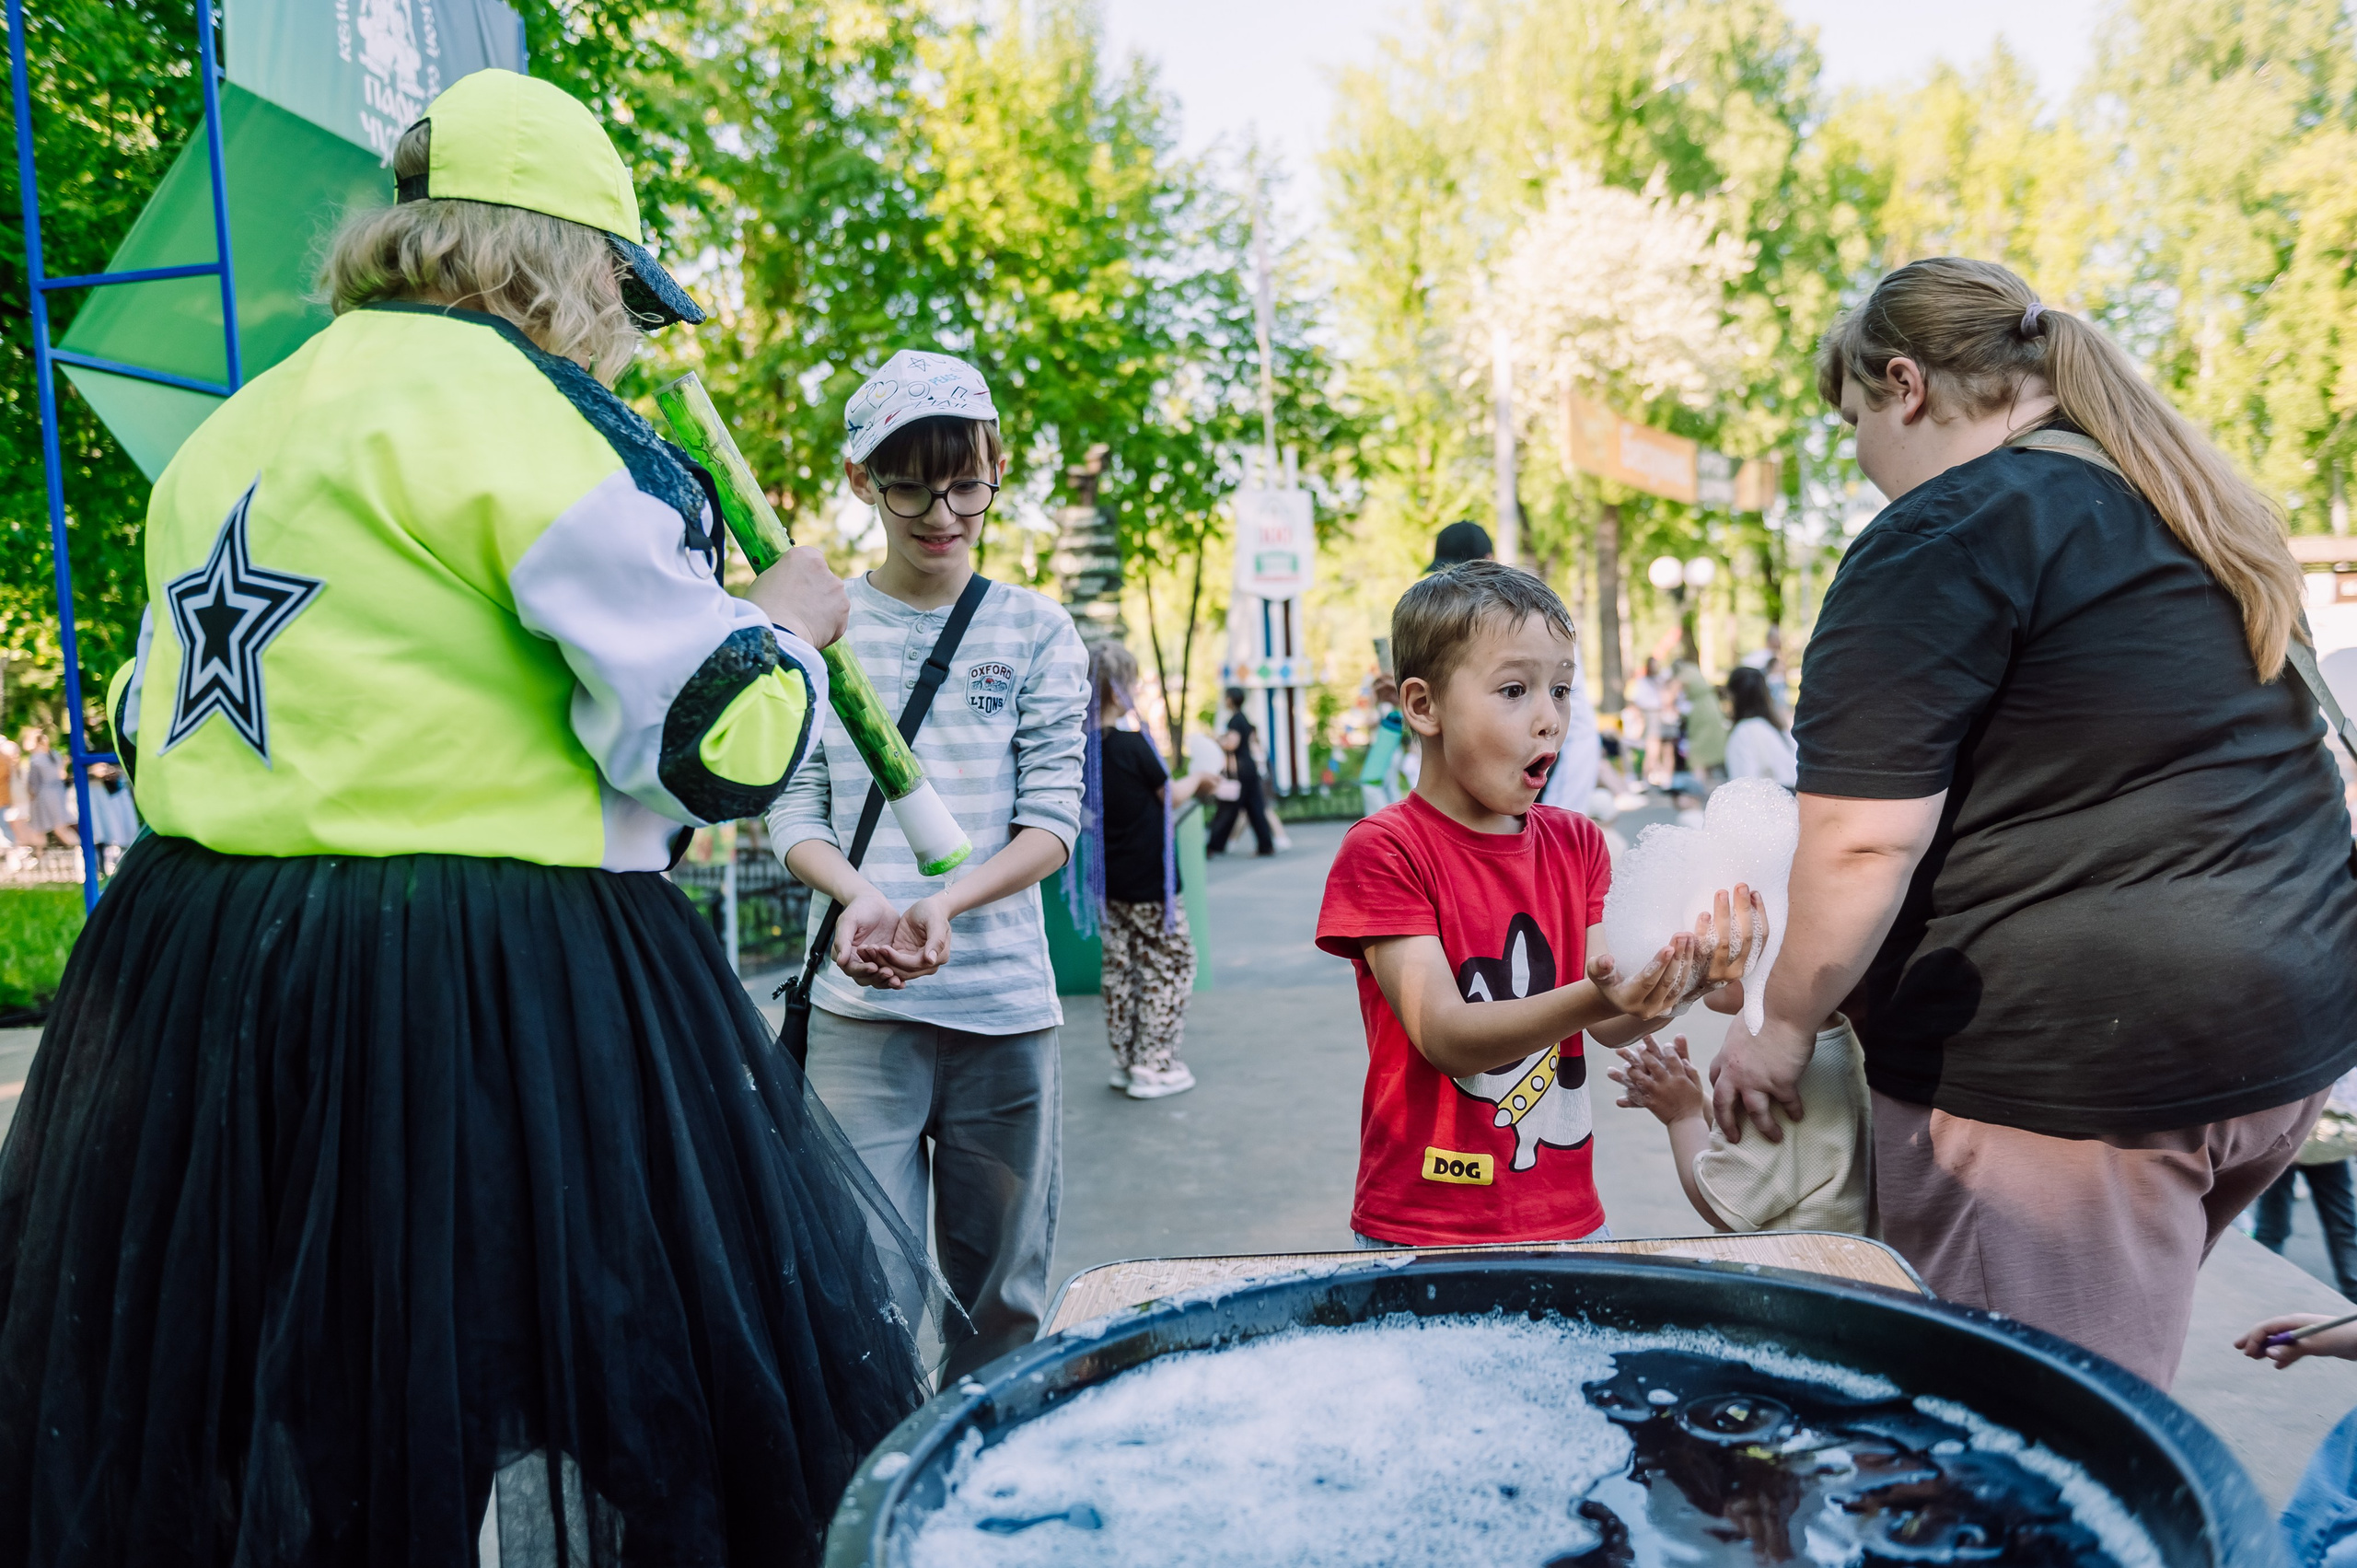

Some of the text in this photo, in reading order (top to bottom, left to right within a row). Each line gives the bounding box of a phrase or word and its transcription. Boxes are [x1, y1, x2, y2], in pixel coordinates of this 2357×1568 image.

[971, 665, 1012, 679] OXFORD
[970, 696, 1004, 714] LIONS
[1434, 1156, 1480, 1179] DOG
